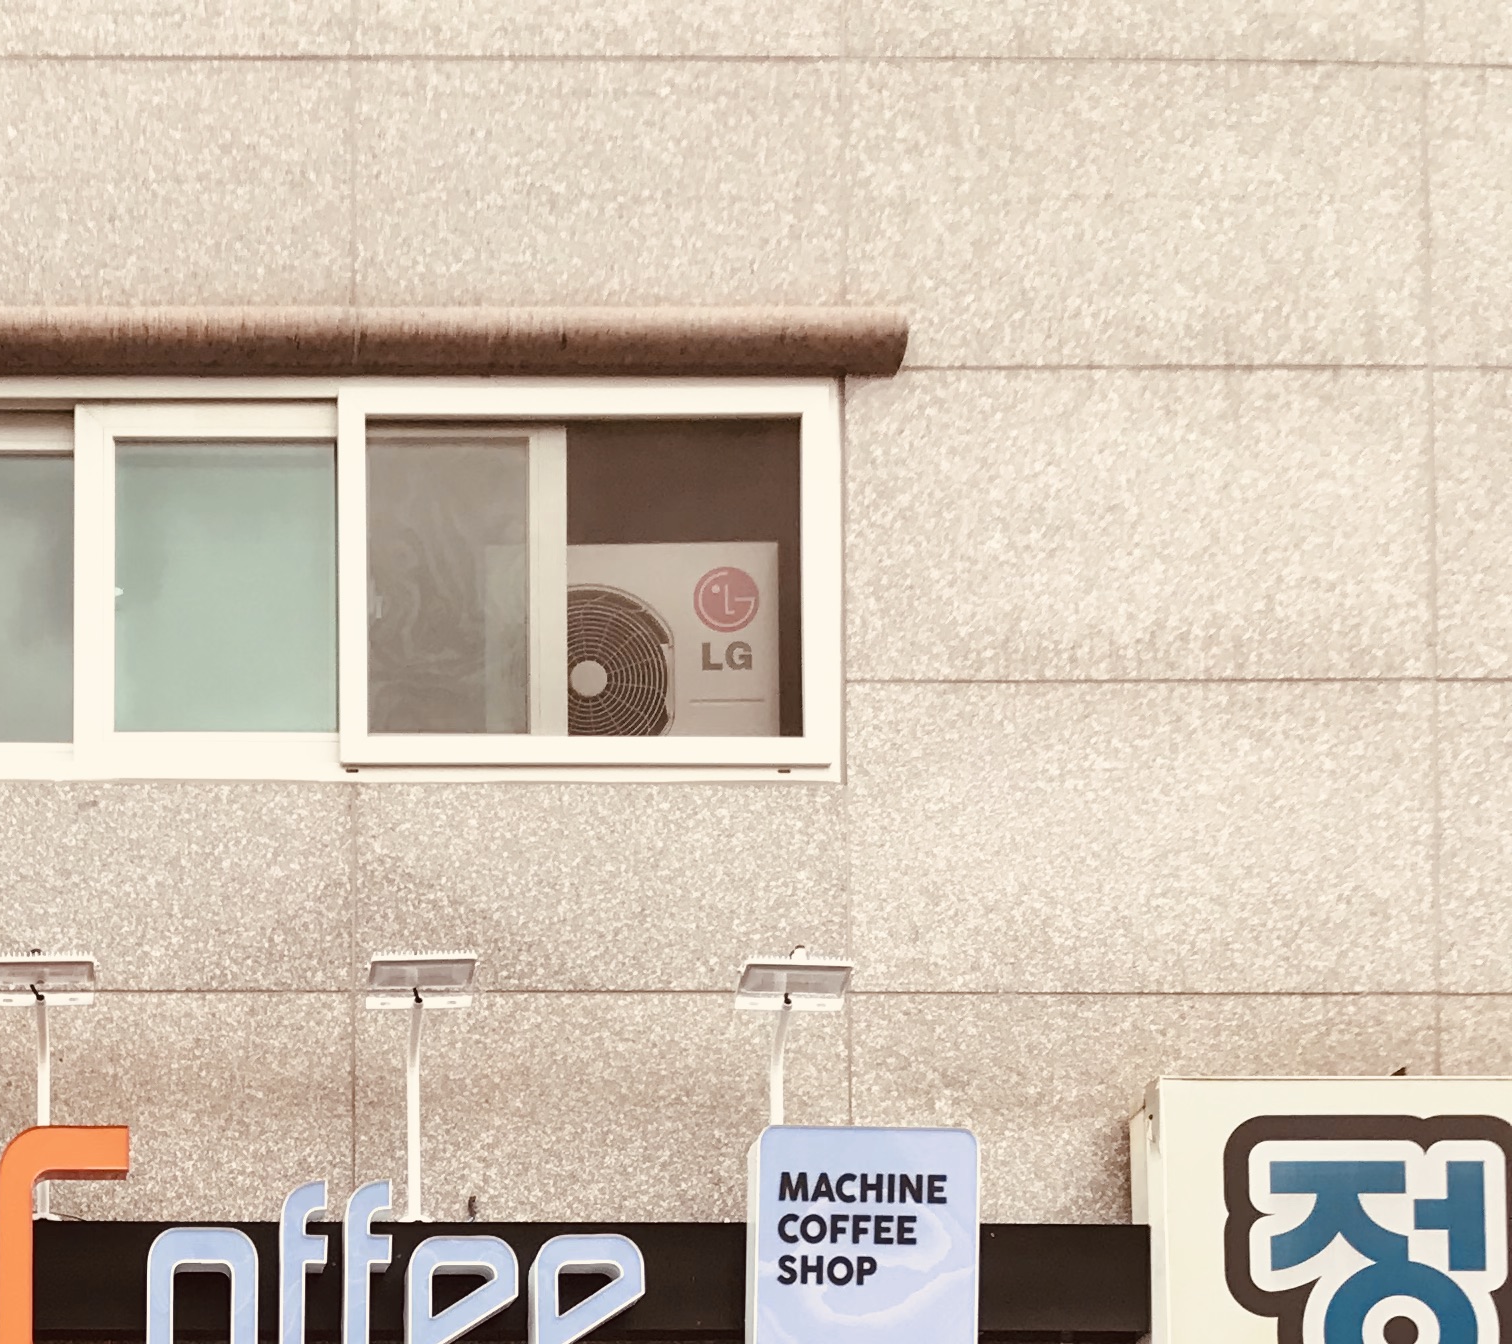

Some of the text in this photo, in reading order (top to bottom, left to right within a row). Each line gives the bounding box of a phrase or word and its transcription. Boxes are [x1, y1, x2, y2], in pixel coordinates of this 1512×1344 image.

[701, 640, 753, 671] LG
[778, 1171, 948, 1206] MACHINE
[777, 1214, 918, 1248] COFFEE
[777, 1255, 879, 1287] SHOP
